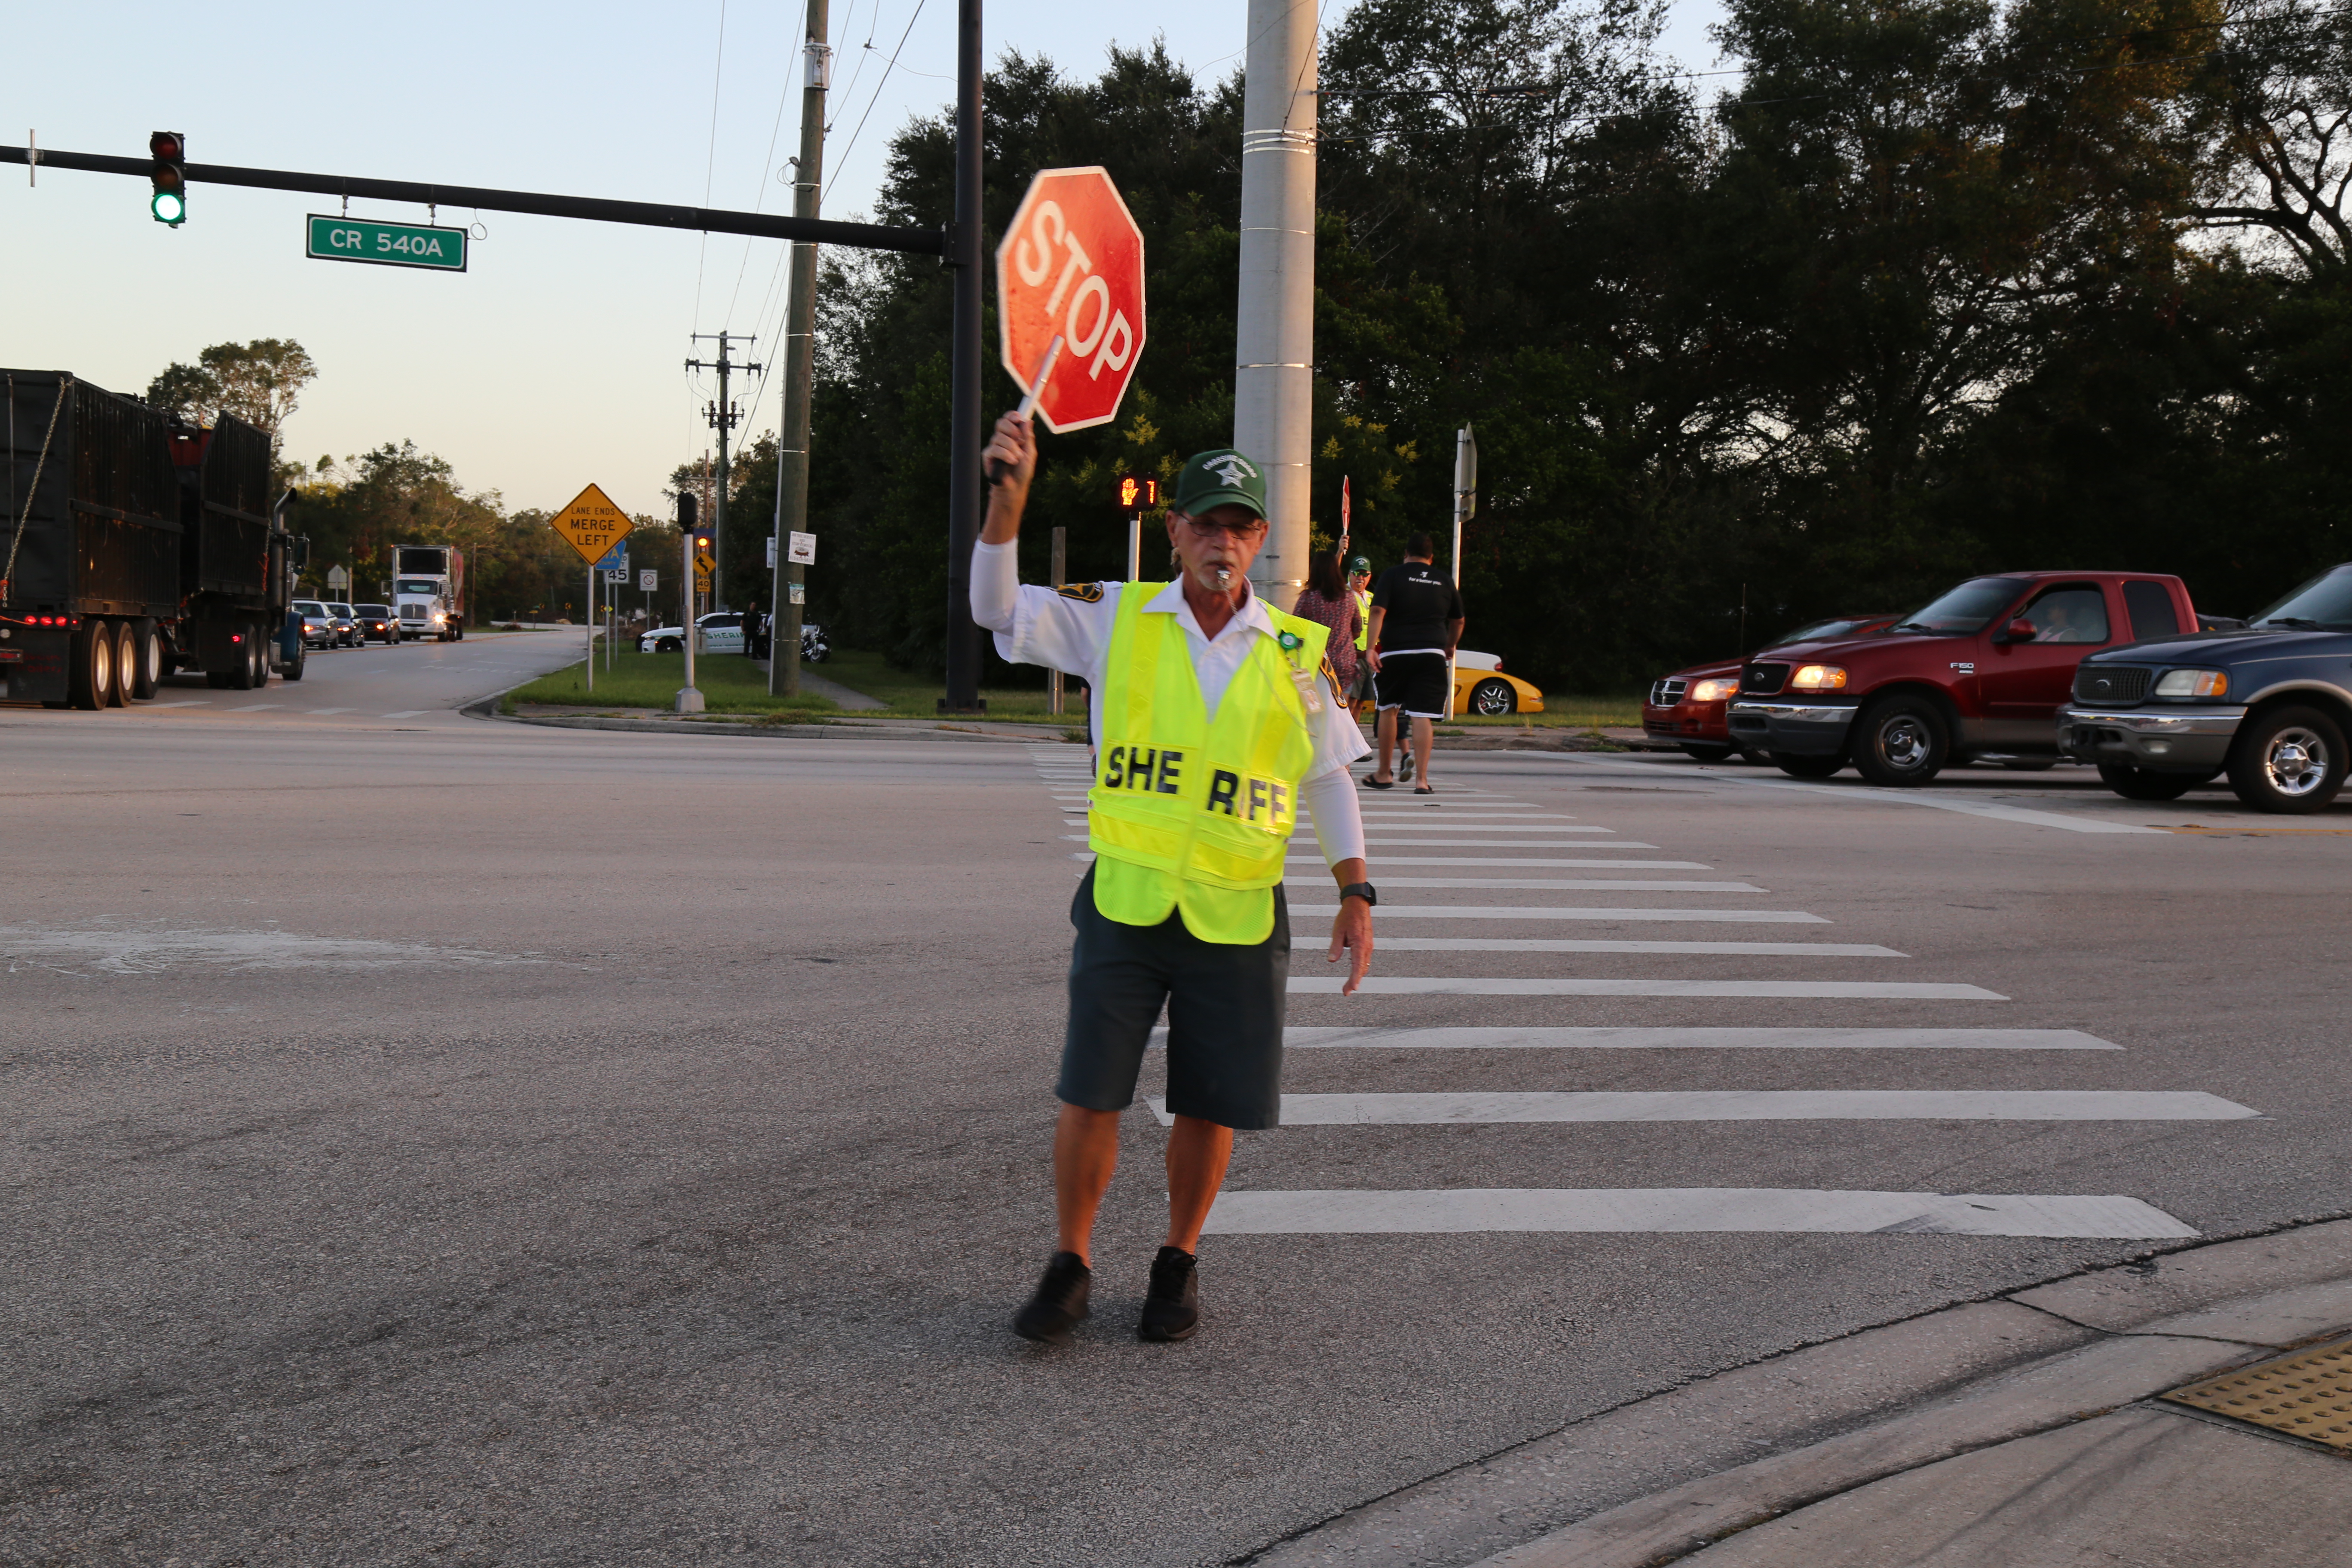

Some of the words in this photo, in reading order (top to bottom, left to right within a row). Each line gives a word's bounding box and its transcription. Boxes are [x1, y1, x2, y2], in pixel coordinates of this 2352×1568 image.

[330, 229, 362, 249] CR
[377, 233, 443, 257] 540A
[1016, 200, 1133, 381] STOP
[571, 519, 616, 530] MERGE
[577, 534, 609, 546] LEFT
[609, 570, 627, 580] 45
[1105, 746, 1184, 795] SHE
